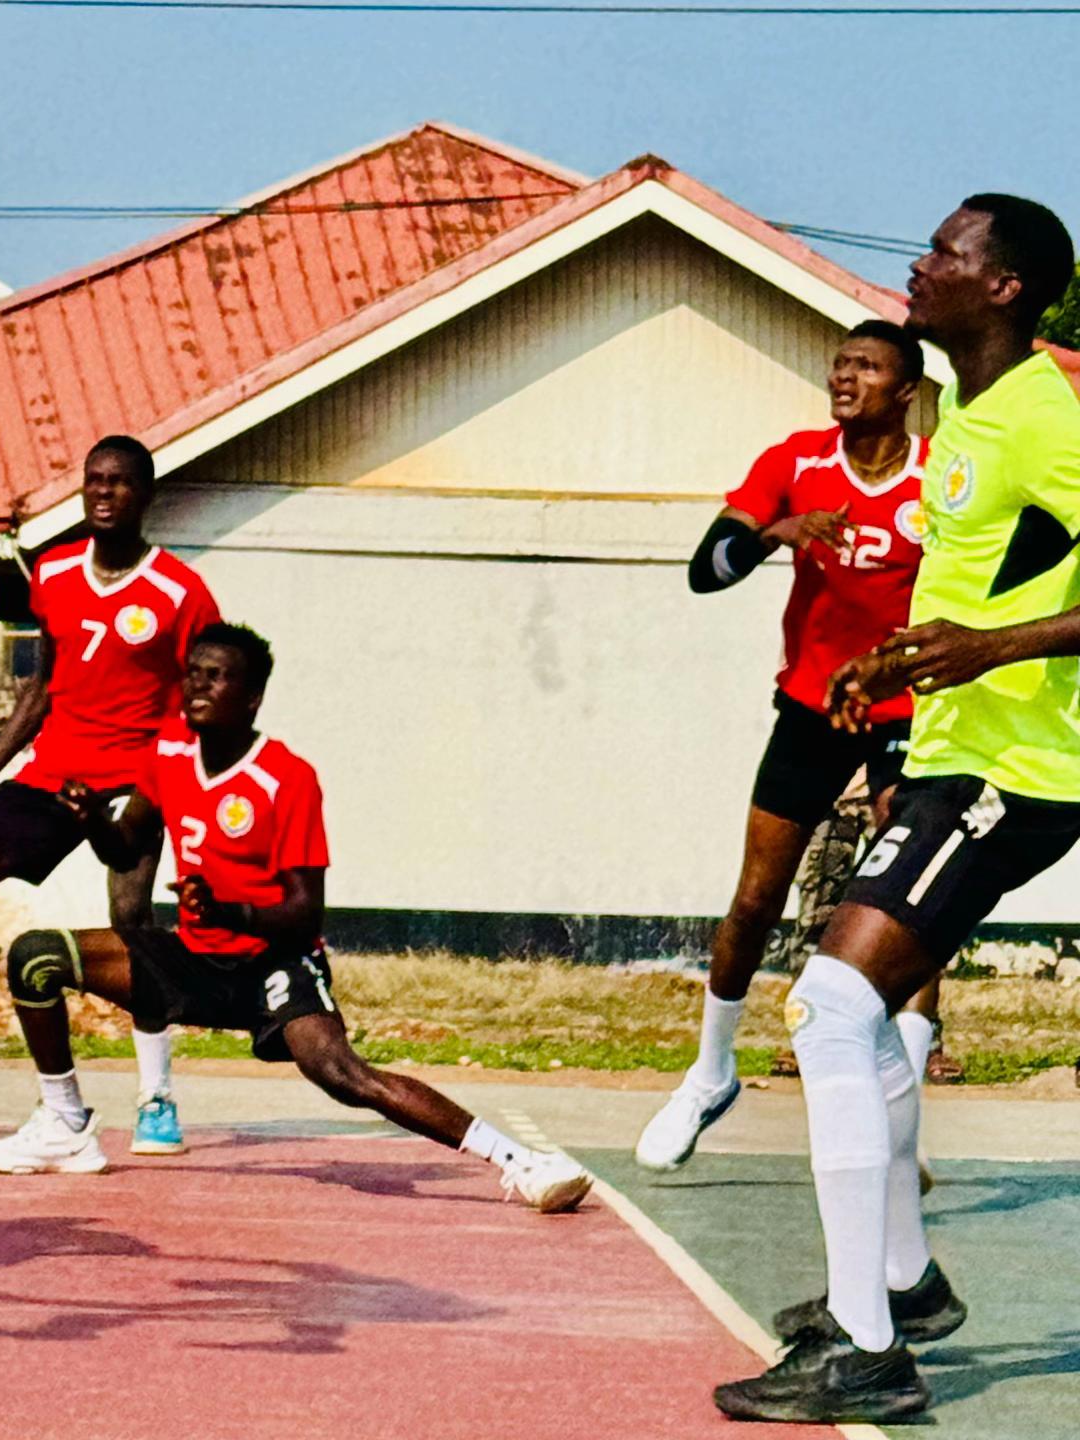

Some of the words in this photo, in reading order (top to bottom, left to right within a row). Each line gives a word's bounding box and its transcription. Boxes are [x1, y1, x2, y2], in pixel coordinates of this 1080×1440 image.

[839, 525, 893, 569] 12
[81, 619, 107, 662] 7
[180, 815, 207, 866] 2
[856, 825, 912, 878] 6
[265, 970, 290, 1011] 2
